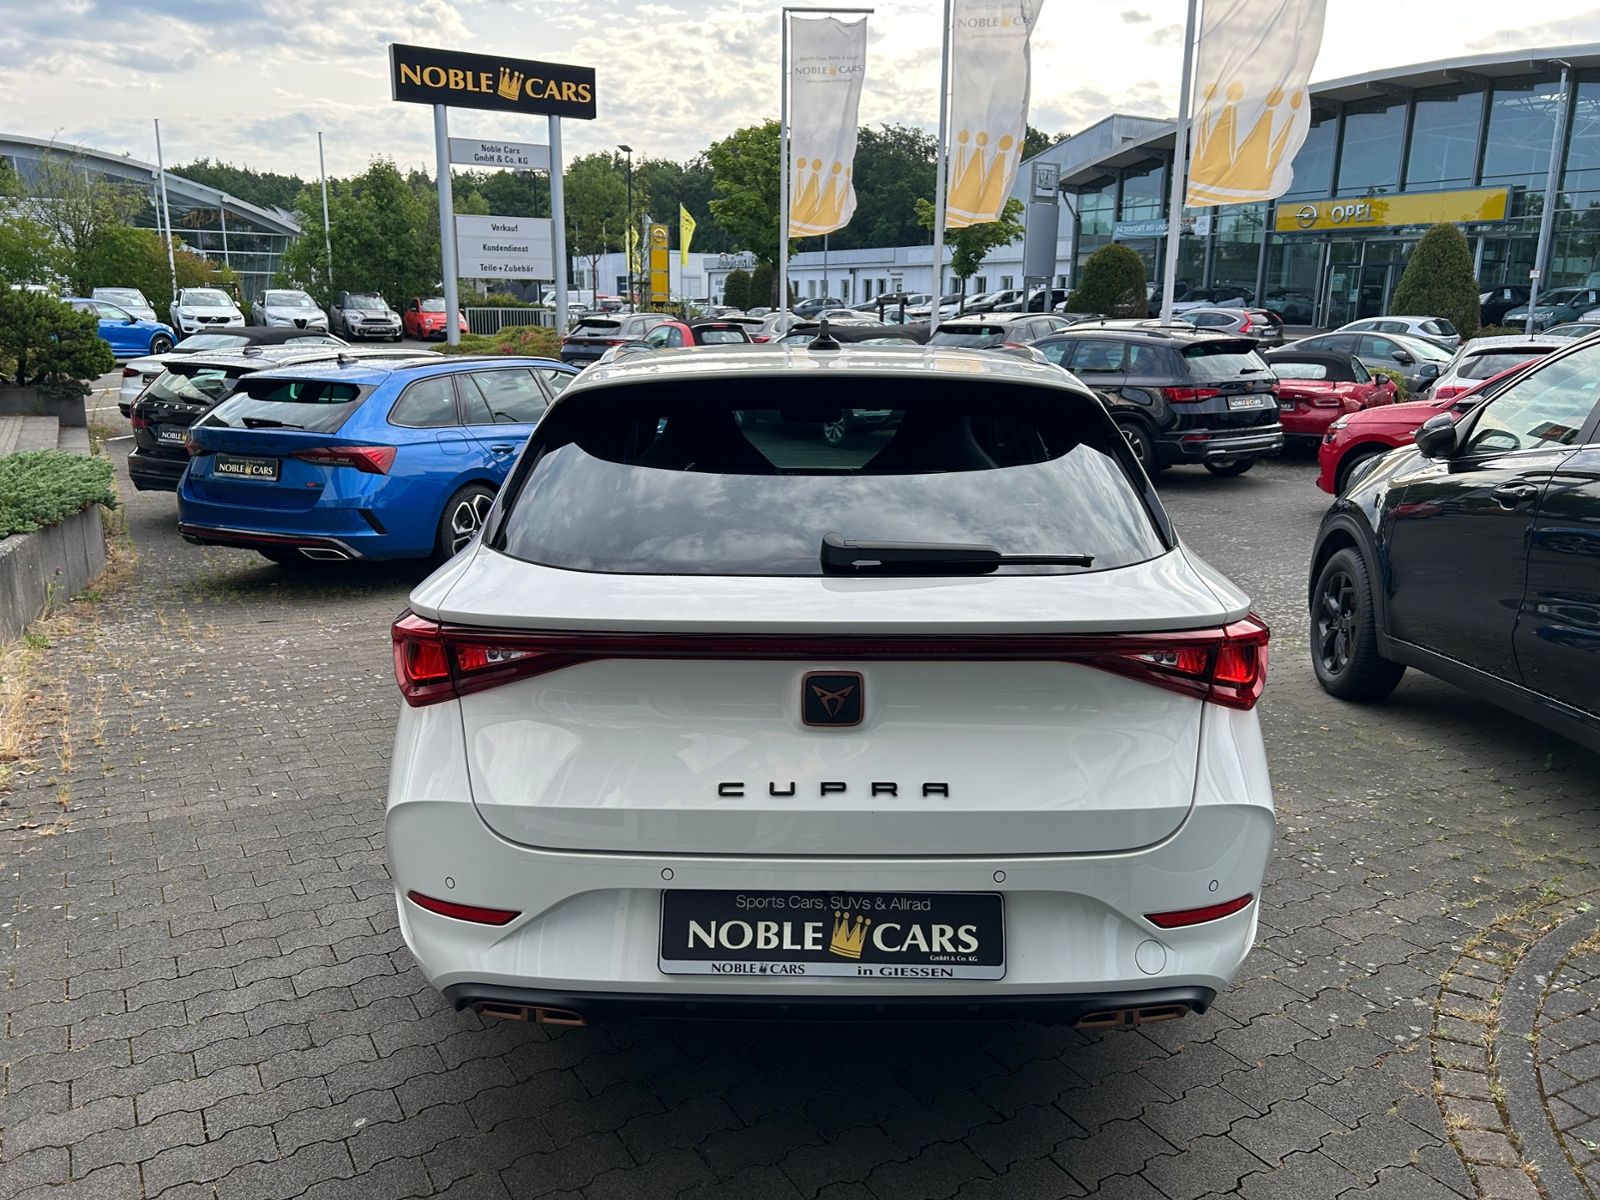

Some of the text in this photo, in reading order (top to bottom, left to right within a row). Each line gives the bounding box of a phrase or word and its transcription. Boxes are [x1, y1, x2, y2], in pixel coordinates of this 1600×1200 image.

[957, 17, 999, 28] NOBLE
[795, 64, 864, 75] NOBLE CARS
[400, 63, 592, 103] NOBLE CARS
[481, 144, 520, 155] Noble Cars
[474, 153, 529, 165] GmbH & Co. KG
[1331, 202, 1374, 224] OPEL
[491, 223, 519, 233] Verkauf
[482, 243, 529, 253] Kundendienst
[479, 263, 534, 273] Teile+Zubehör
[161, 431, 182, 440] NOBLE
[218, 463, 273, 475] NOBLE CARS
[718, 781, 949, 798] CUPRA
[735, 895, 931, 911] Sports Cars, SUVs & Allrad
[687, 919, 979, 953] NOBLE CARS
[711, 962, 806, 975] NOBLE CARS
[857, 965, 954, 978] in GIESSEN
